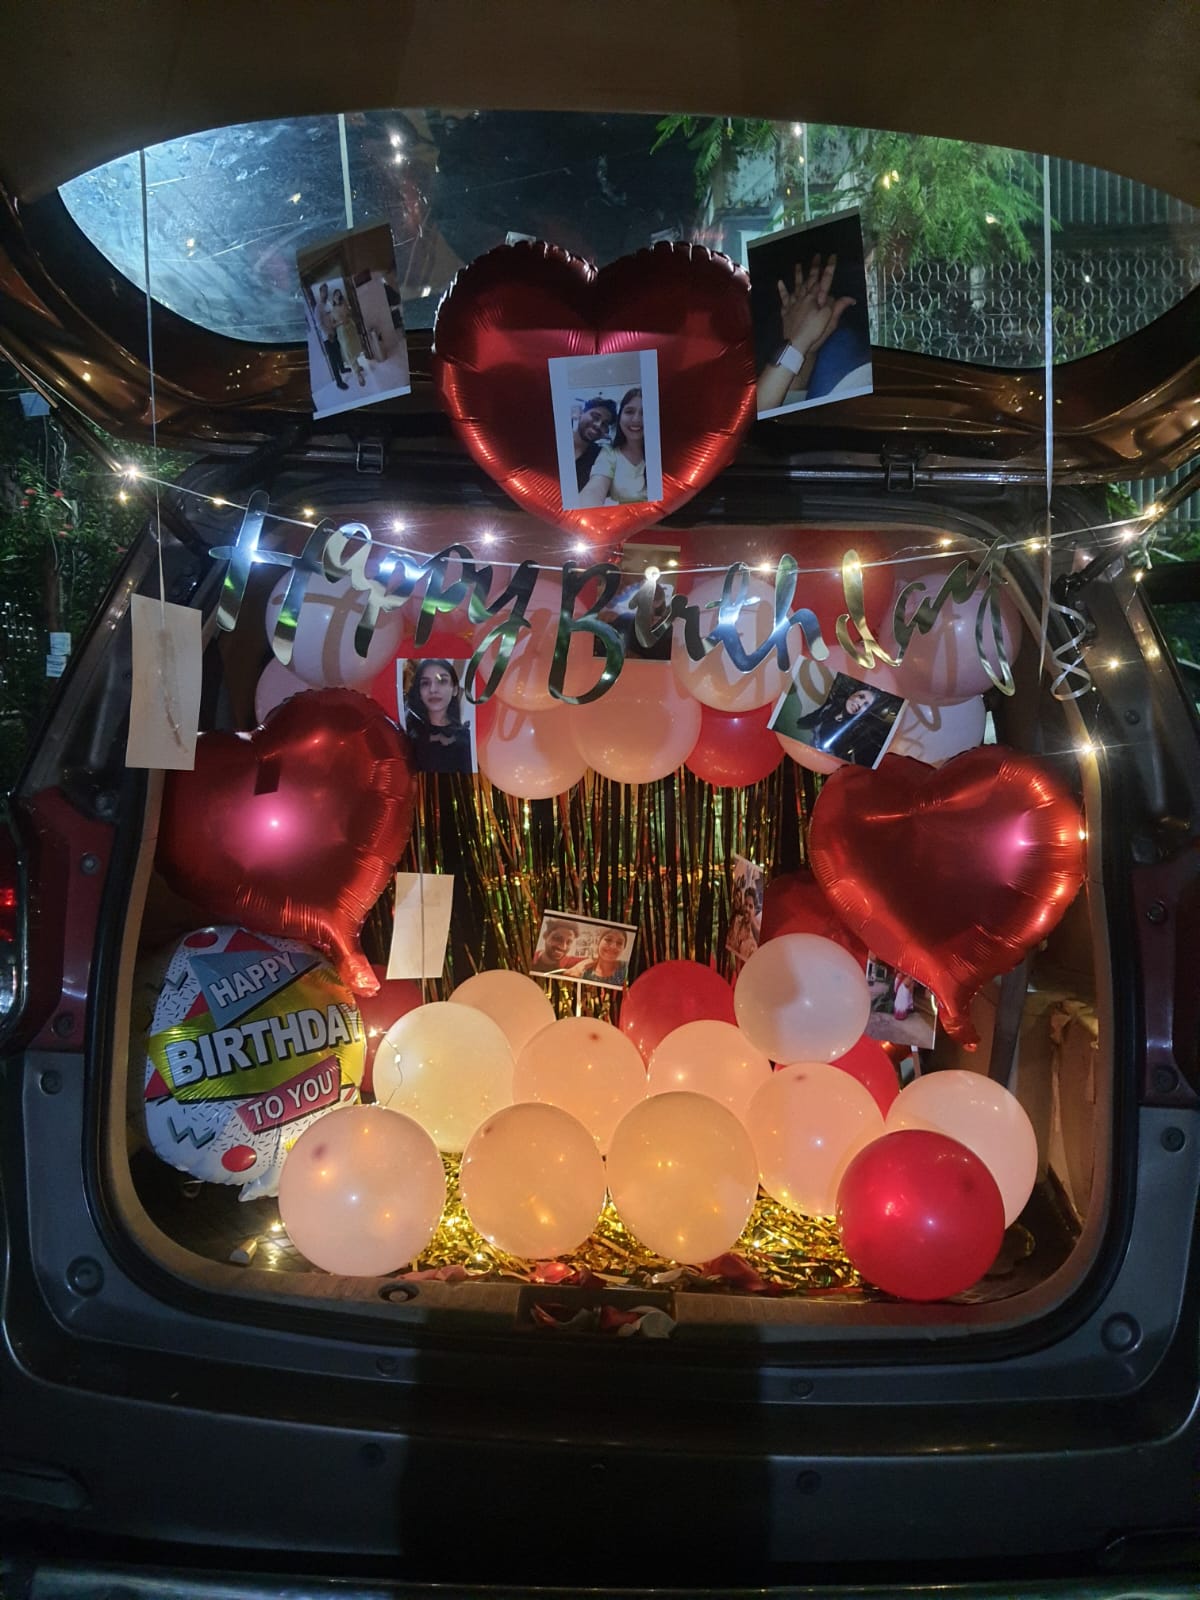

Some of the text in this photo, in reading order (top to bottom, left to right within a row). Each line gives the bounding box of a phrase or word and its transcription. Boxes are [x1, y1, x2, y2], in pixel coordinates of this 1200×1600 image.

[208, 490, 1016, 704] Happy Birthday
[208, 952, 297, 1008] HAPPY
[165, 1003, 361, 1088] BIRTHDAY
[248, 1070, 333, 1126] TO YOU
